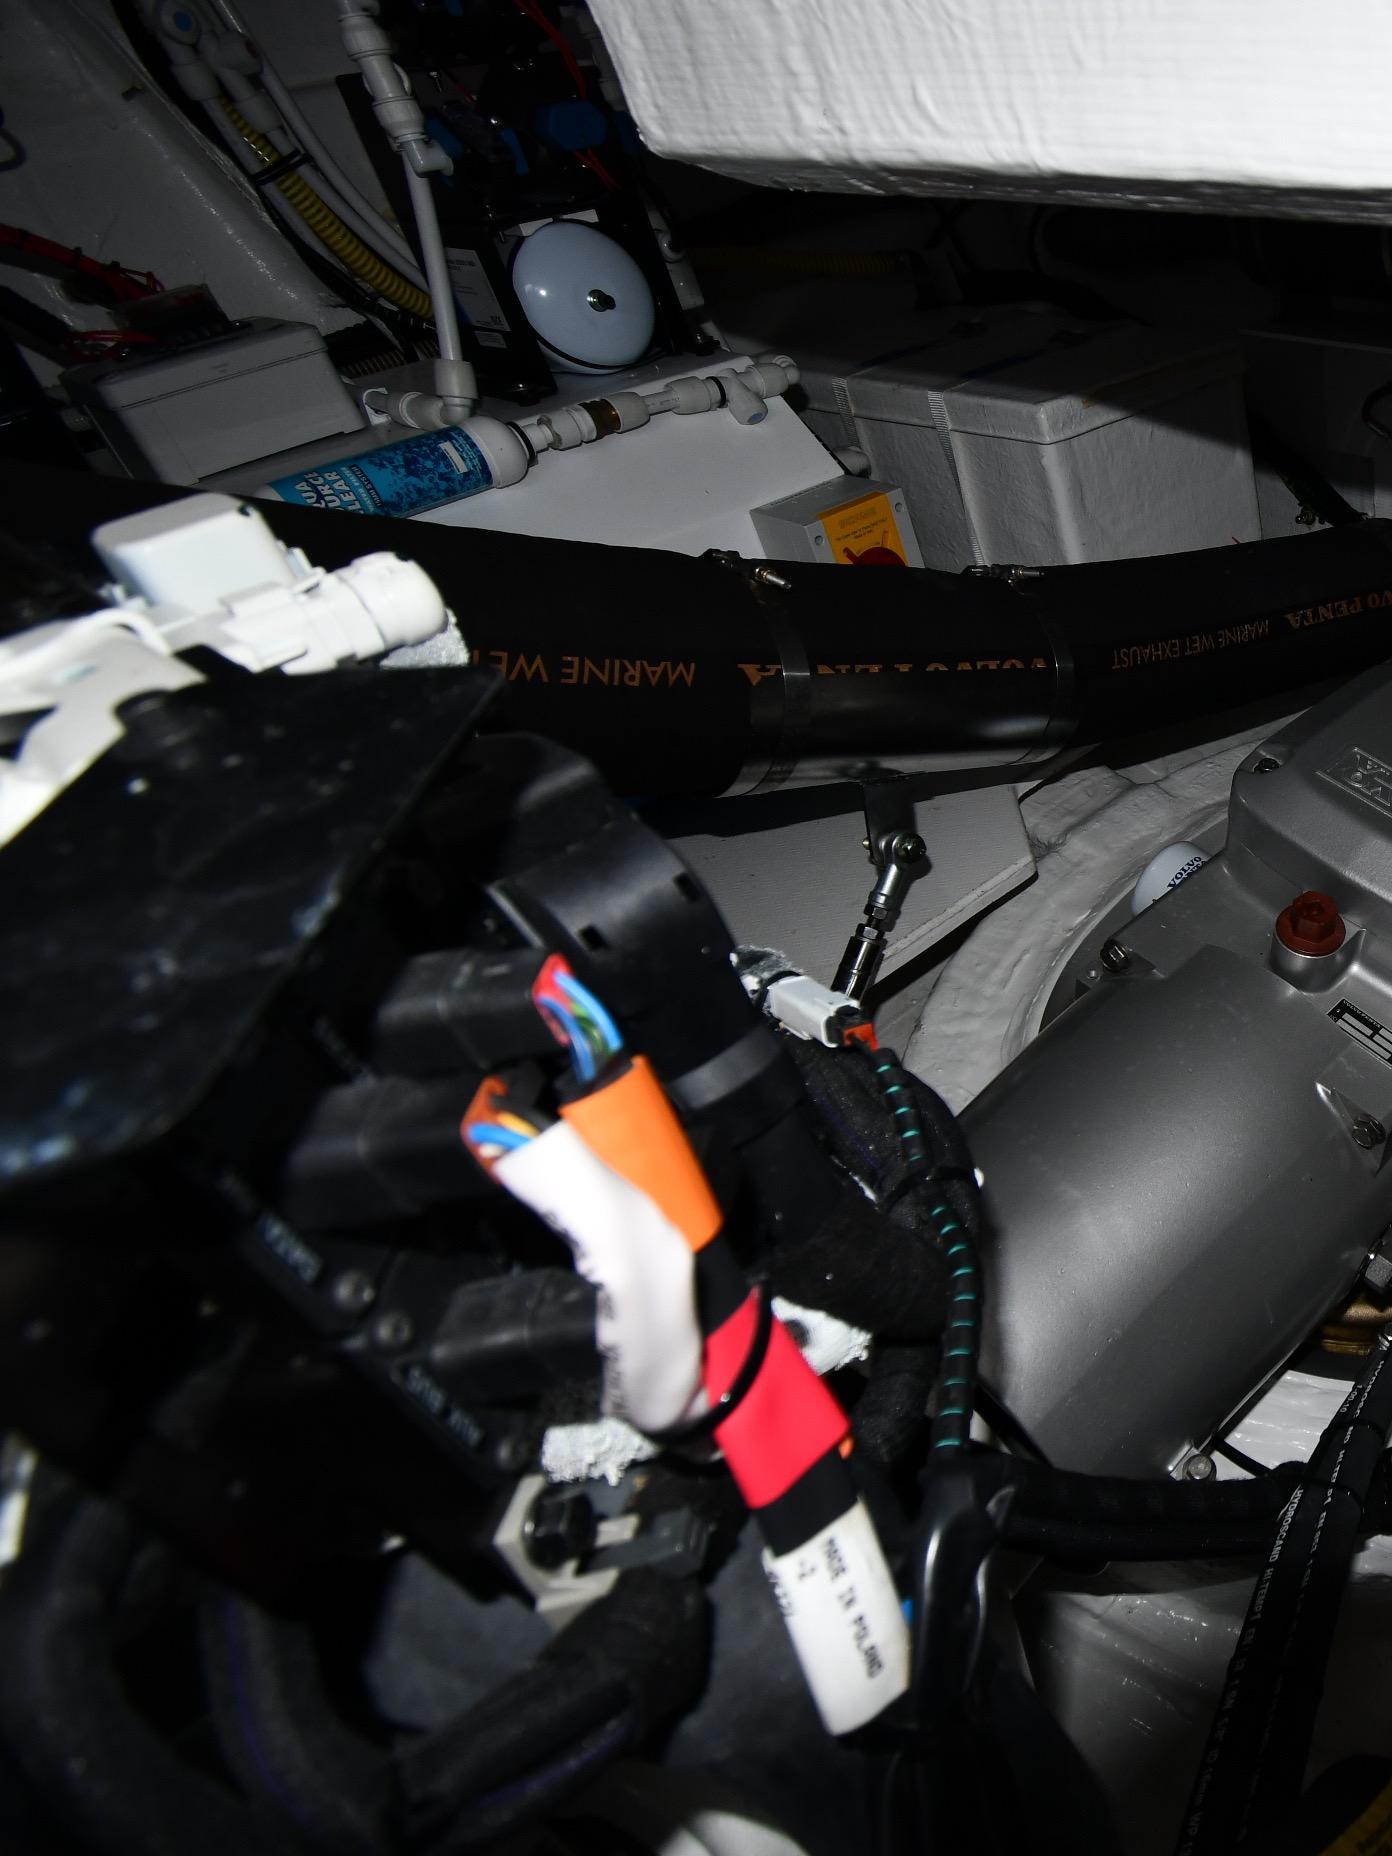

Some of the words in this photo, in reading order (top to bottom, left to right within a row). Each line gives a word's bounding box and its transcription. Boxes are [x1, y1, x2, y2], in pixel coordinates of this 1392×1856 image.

[324, 471, 365, 514] LEAR
[1283, 595, 1363, 630] PENTA
[1183, 632, 1218, 656] WET
[1216, 618, 1270, 648] MARINE
[467, 648, 549, 684] WE
[559, 655, 696, 688] MARINE
[1111, 639, 1180, 671] EXHAUST
[1167, 855, 1202, 889] VOLVO
[1269, 1488, 1304, 1563] HYDROSCAND
